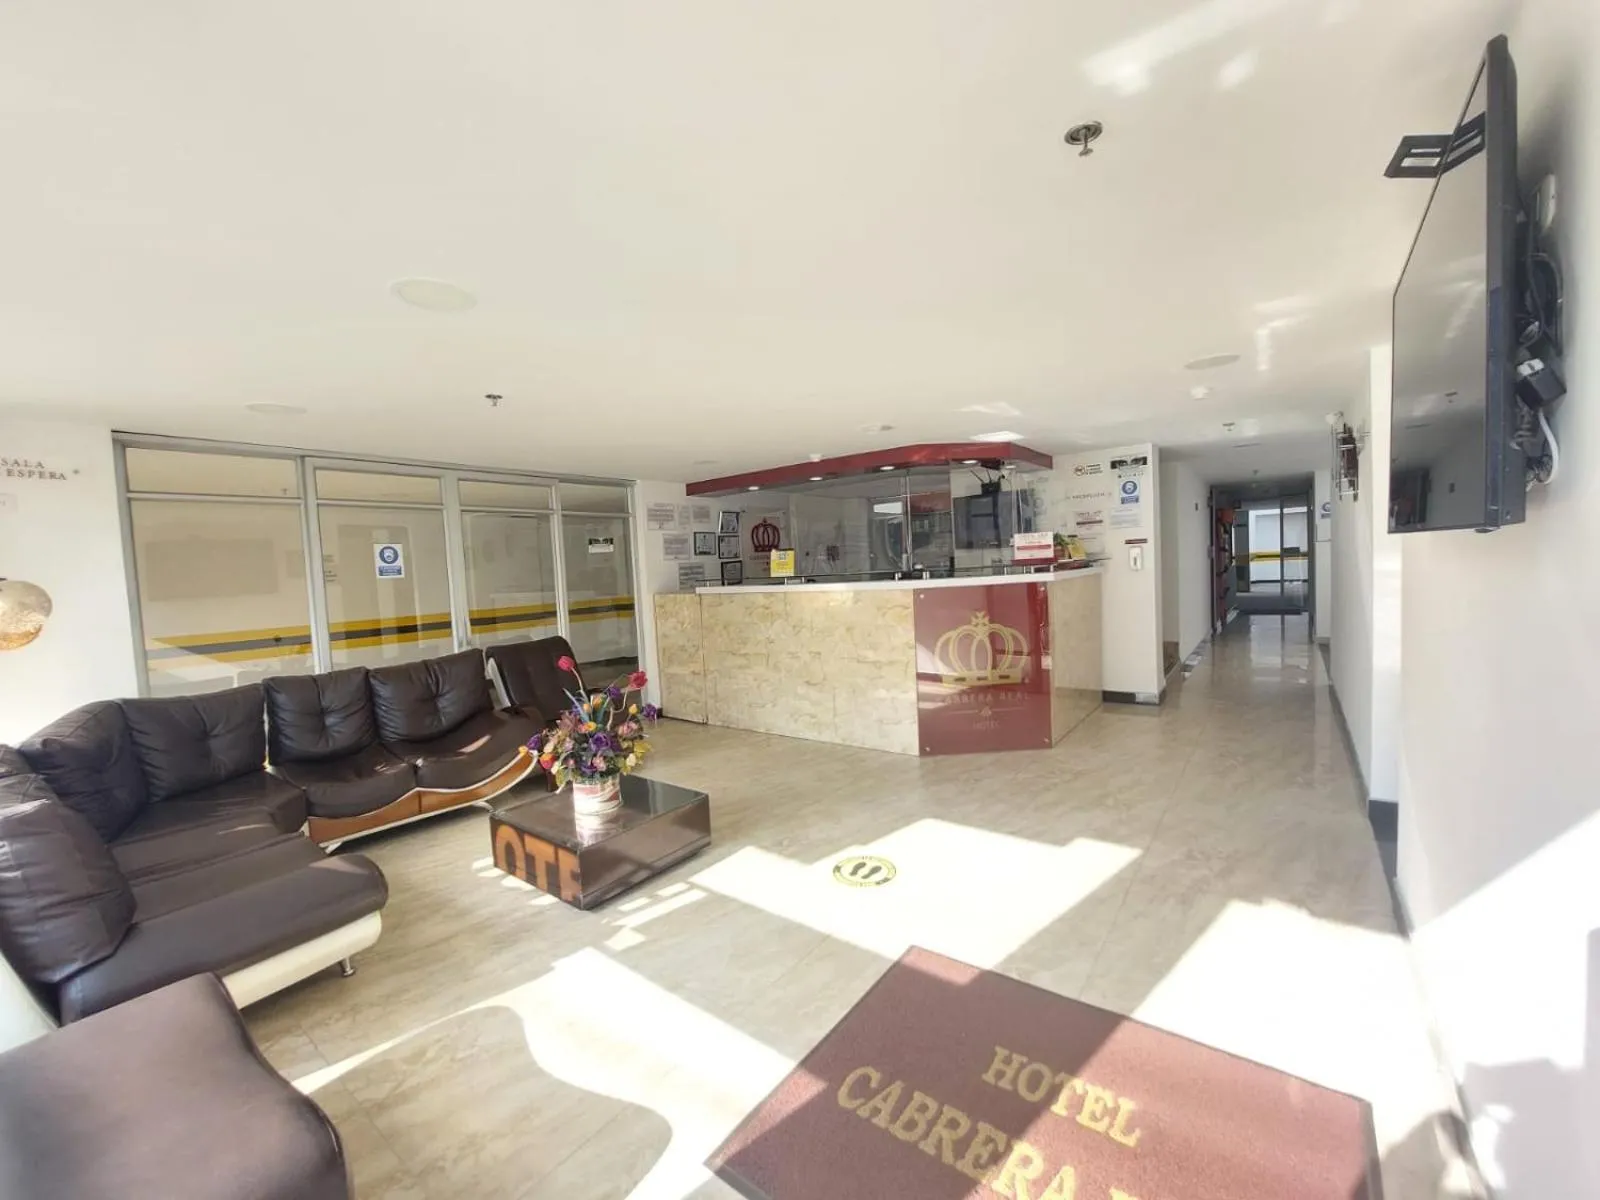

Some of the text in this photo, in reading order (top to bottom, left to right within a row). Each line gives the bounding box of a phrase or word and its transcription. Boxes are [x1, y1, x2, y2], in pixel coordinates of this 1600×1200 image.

[0, 457, 45, 469] SALA
[6, 468, 67, 480] ESPERA
[982, 1045, 1141, 1148] HOTEL
[837, 1065, 1077, 1200] CABRERA
